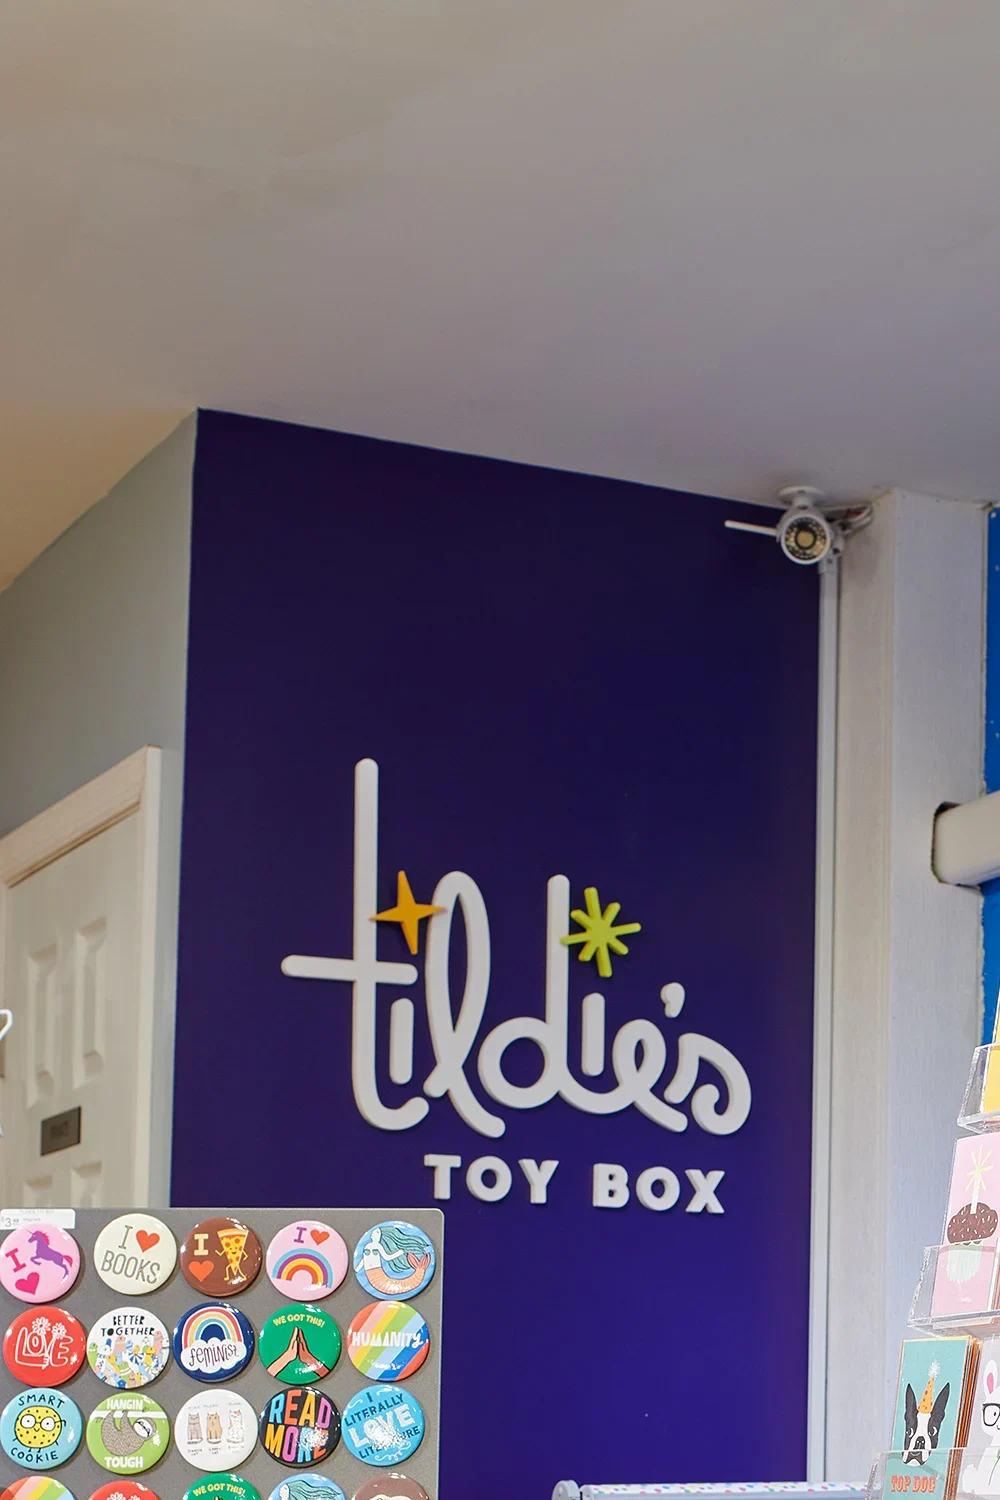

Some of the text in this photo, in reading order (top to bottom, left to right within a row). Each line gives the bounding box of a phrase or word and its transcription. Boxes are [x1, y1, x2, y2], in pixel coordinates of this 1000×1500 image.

[281, 757, 752, 1138] tildie's
[424, 1153, 725, 1214] TOY BOX
[101, 1250, 161, 1285] BOOKS
[112, 1315, 145, 1326] BETTER
[273, 1313, 326, 1328] WE GOT THIS!
[101, 1326, 155, 1337] TOGETHER
[352, 1330, 423, 1350] HUMANITY
[18, 1394, 66, 1409] SMART
[106, 1398, 144, 1410] HANGIN
[269, 1389, 332, 1428] READ
[344, 1393, 404, 1427] LITERALLY
[10, 1448, 59, 1464] COOKIE
[103, 1456, 144, 1468] TOUGH
[890, 1474, 936, 1493] TOP DOG
